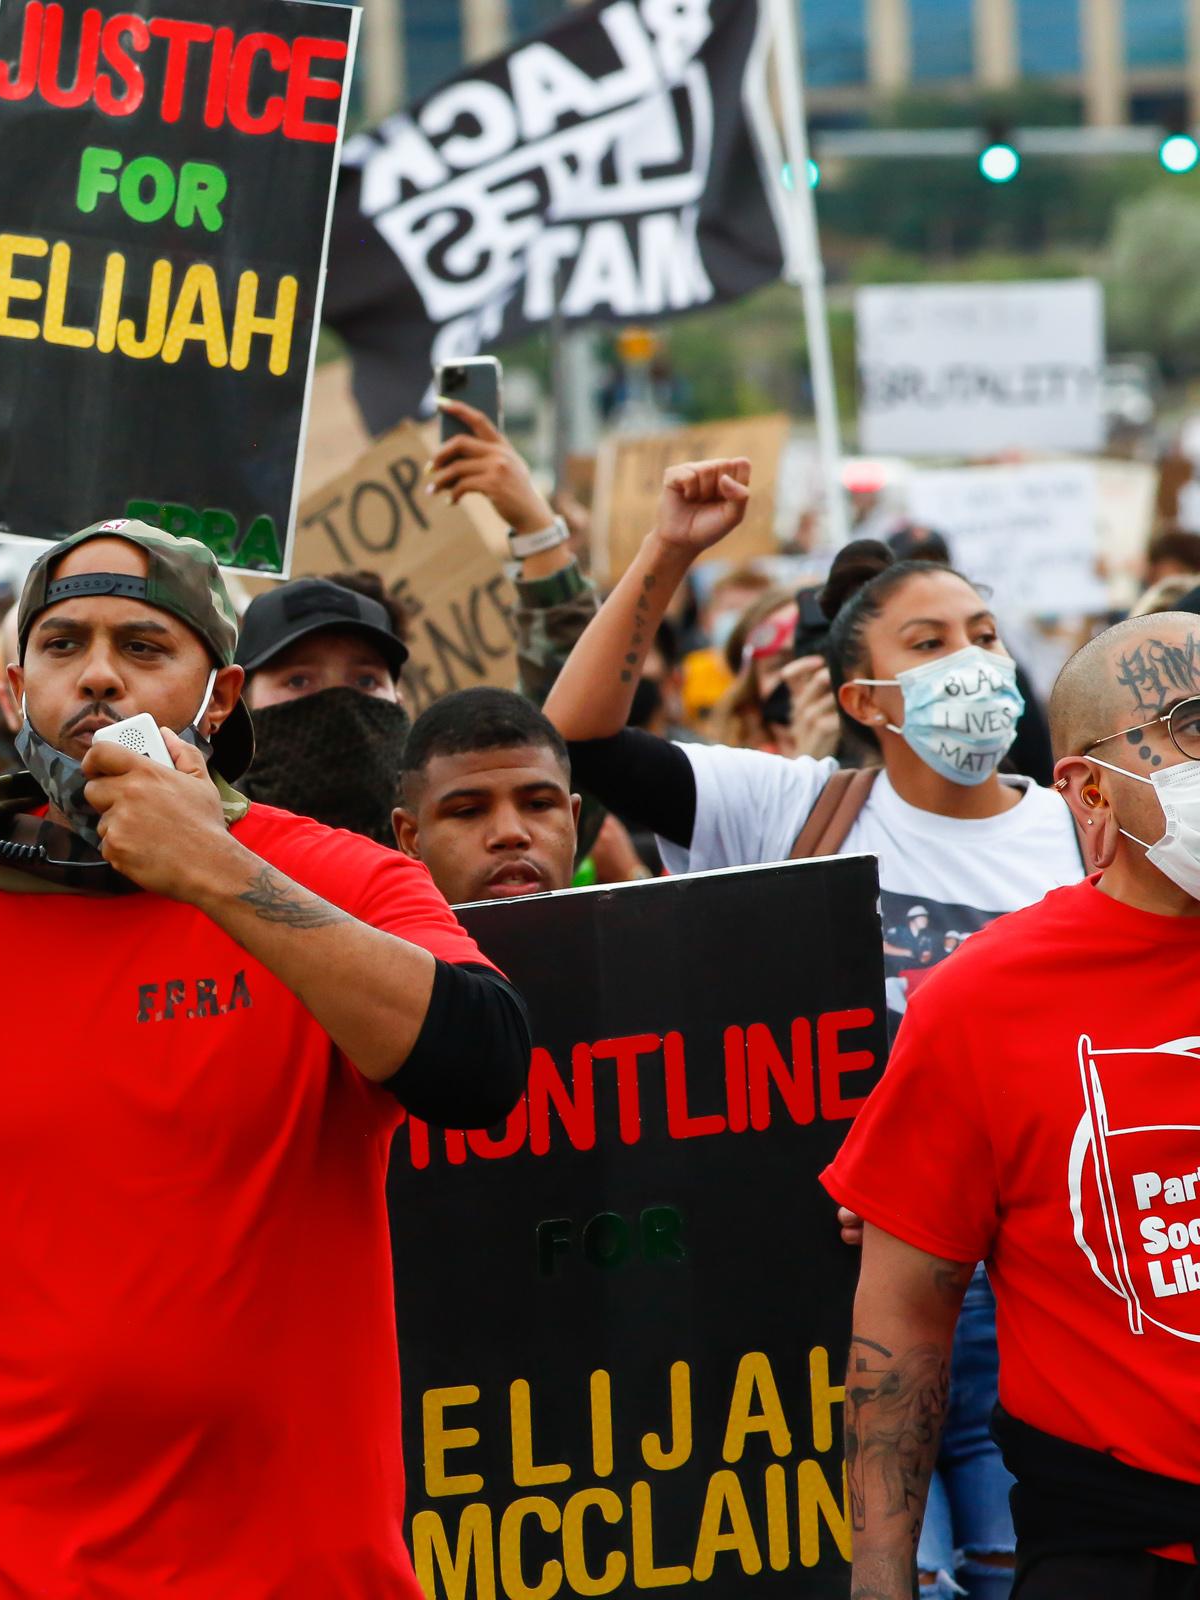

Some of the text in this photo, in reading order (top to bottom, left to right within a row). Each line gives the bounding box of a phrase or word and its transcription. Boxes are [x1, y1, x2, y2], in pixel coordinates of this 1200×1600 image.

[76, 145, 228, 233] FOR
[945, 707, 1012, 734] LIVES
[1132, 1166, 1200, 1211] Par
[533, 1206, 688, 1278] FOR
[412, 1457, 853, 1600] MCCLAIN
